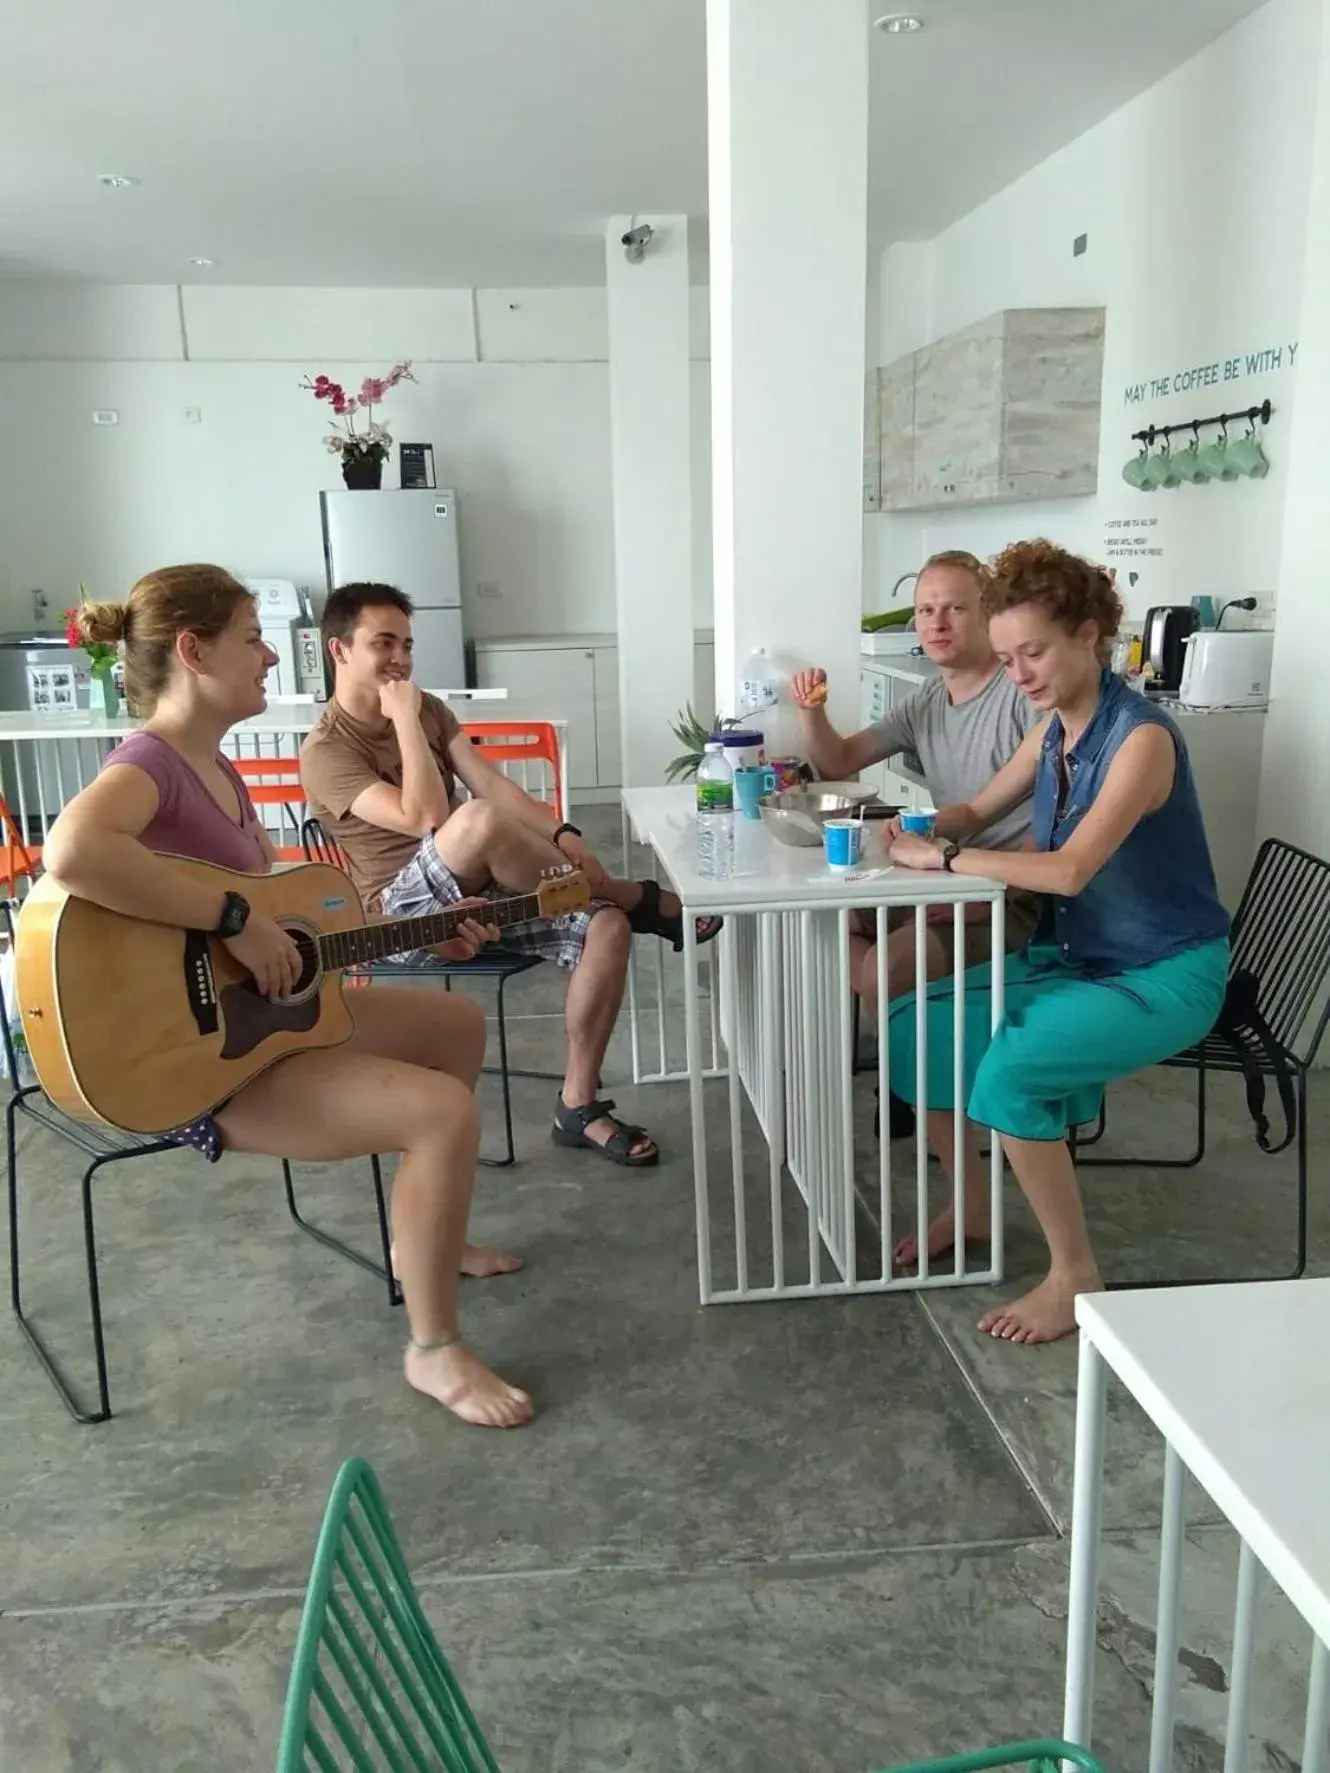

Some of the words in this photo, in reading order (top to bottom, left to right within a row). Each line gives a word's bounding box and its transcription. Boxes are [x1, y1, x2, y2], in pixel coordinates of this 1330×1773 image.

[1124, 383, 1146, 405] MAY
[1151, 377, 1170, 397] THE
[1173, 363, 1219, 393] COFFEE
[1224, 358, 1240, 380] BE
[1245, 347, 1282, 375] WITH
[1288, 342, 1299, 366] Y
